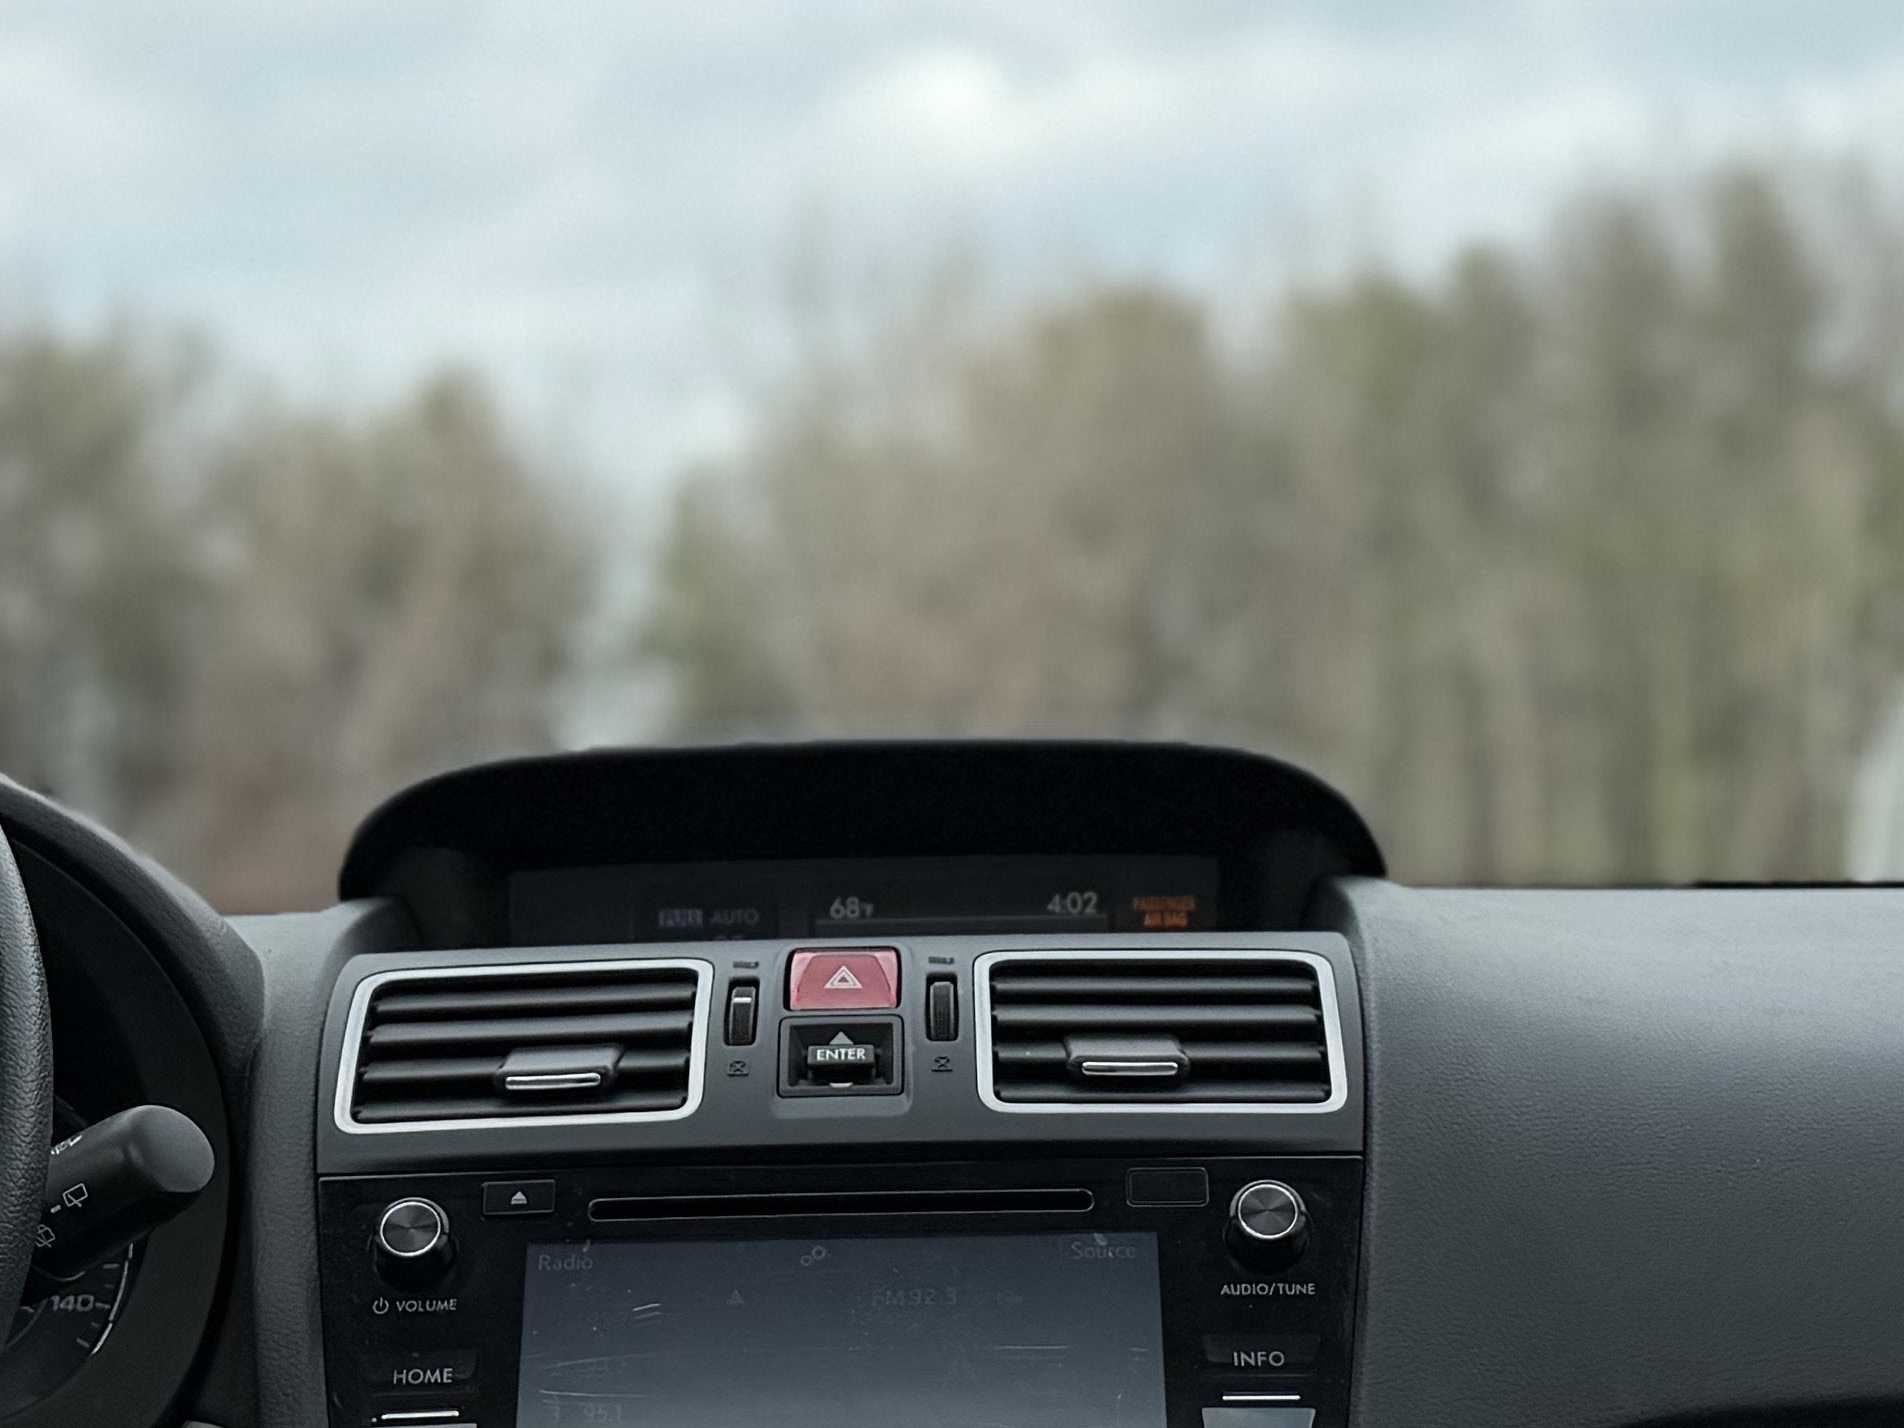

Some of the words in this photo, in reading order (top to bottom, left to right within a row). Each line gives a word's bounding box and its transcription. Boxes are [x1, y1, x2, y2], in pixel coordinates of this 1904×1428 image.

[1047, 891, 1098, 914] 4:02
[710, 909, 759, 925] AUTO
[815, 1047, 868, 1063] ENTER
[1070, 1242, 1137, 1260] Source
[537, 1254, 594, 1272] Radio
[1220, 1283, 1316, 1296] AUDIO/TUNE
[50, 1294, 95, 1311] 140
[396, 1299, 458, 1313] VOLUME
[1232, 1351, 1286, 1367] INFO
[393, 1368, 454, 1385] HOME
